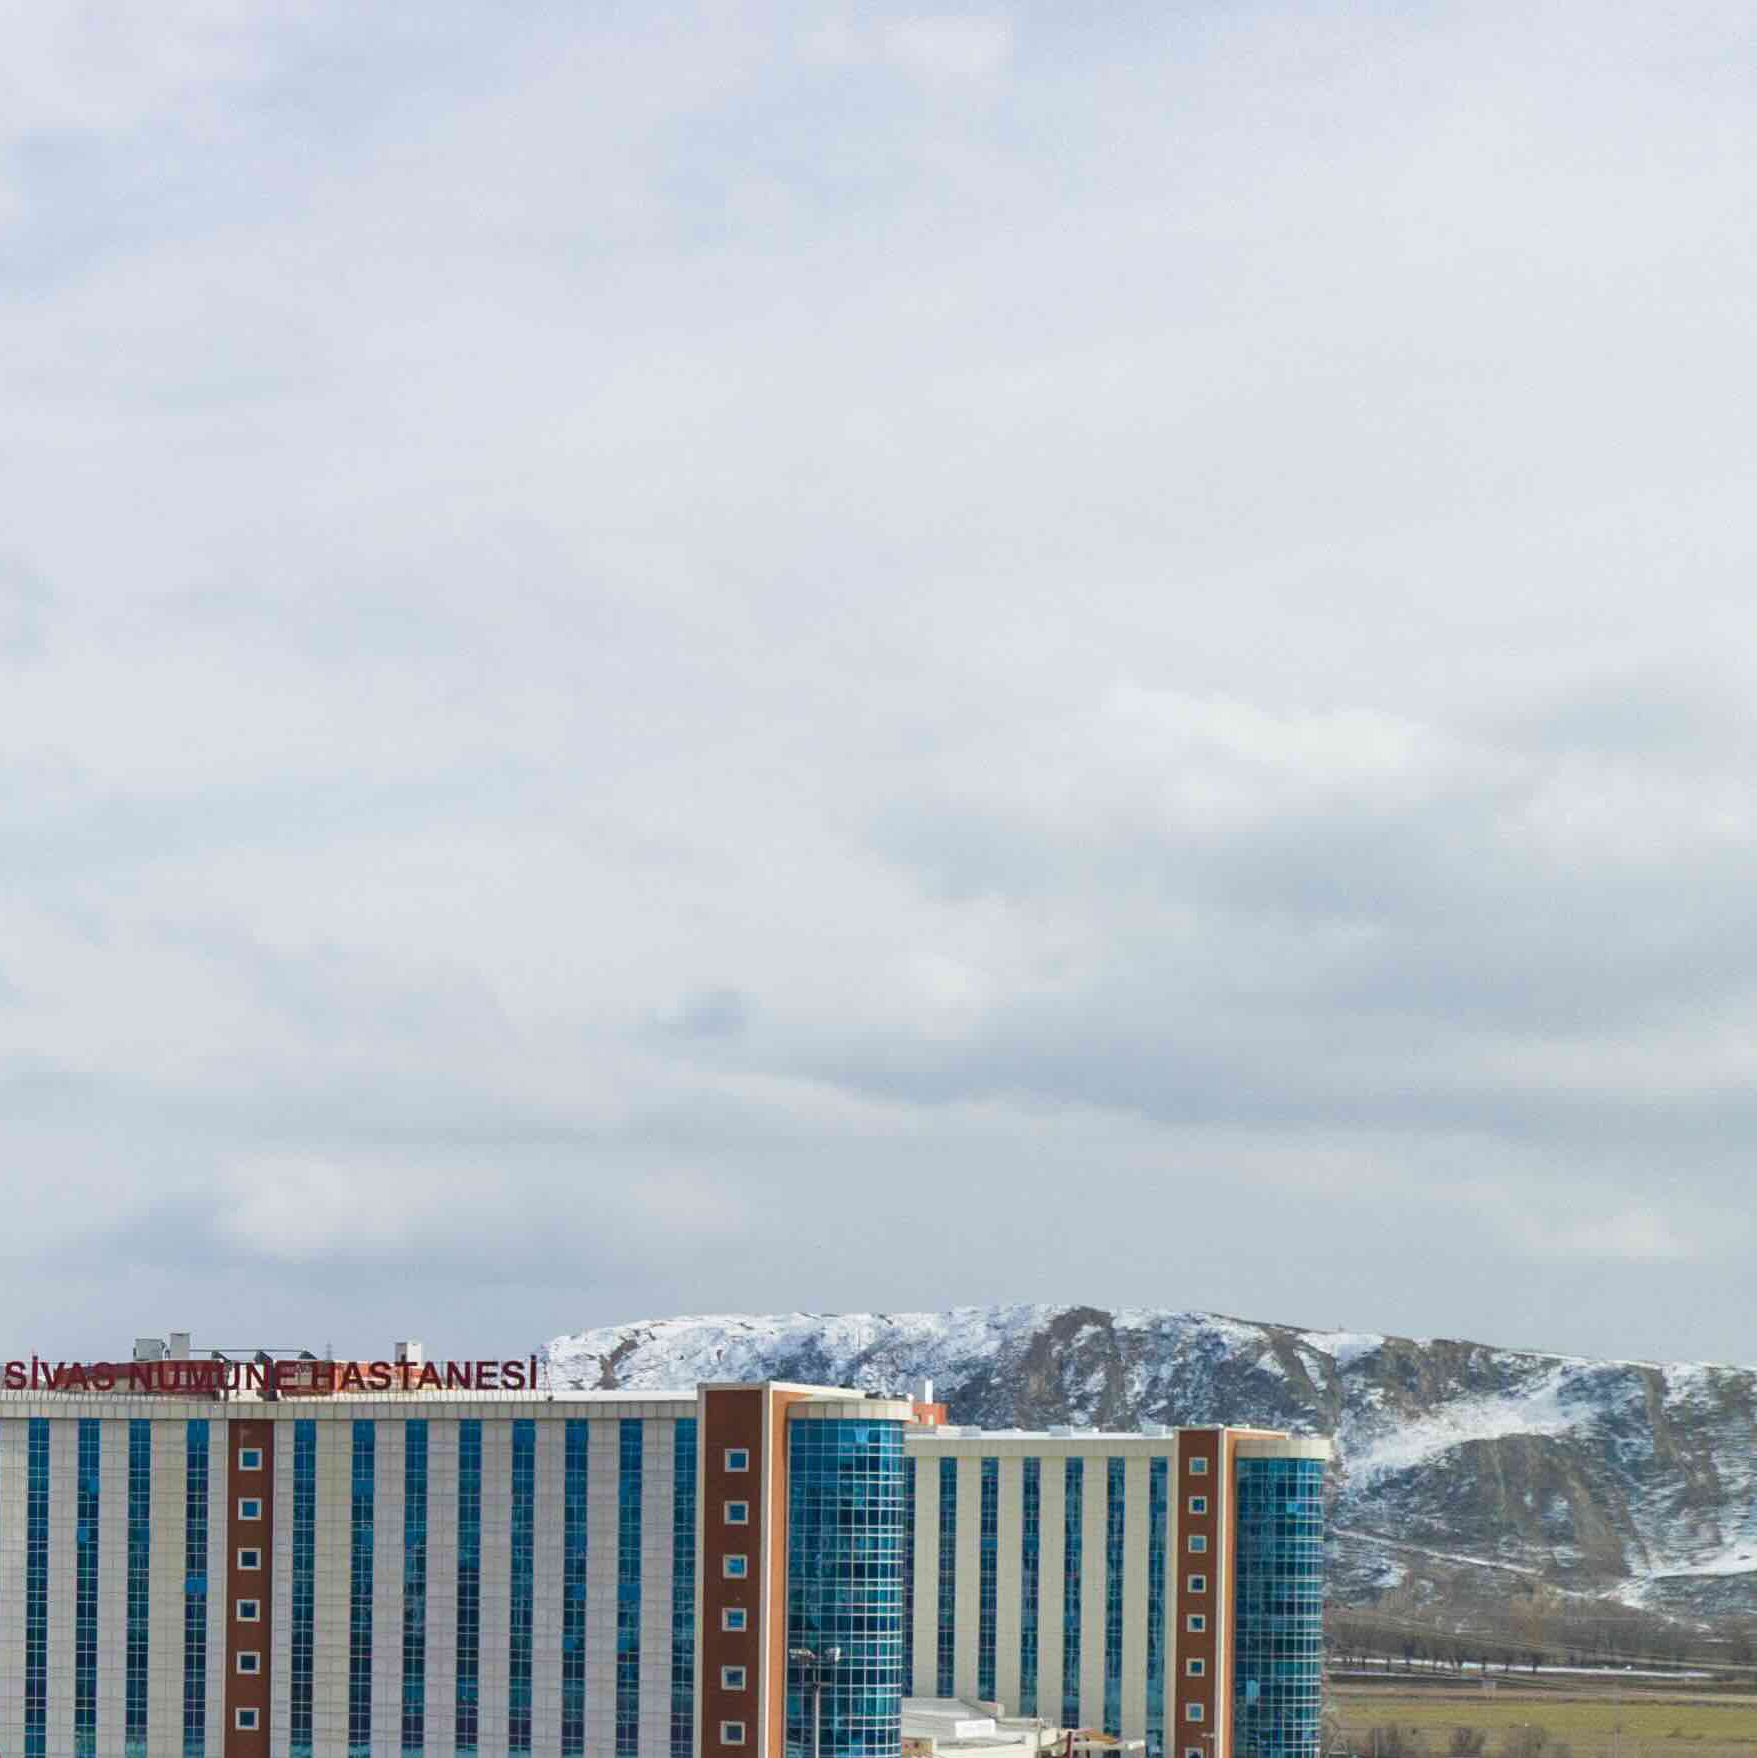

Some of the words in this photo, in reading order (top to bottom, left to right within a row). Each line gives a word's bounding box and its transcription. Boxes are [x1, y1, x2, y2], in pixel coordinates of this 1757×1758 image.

[5, 1355, 116, 1391] SİVAS
[130, 1360, 298, 1392] NUMUNE
[311, 1355, 538, 1391] HASTANESİ
